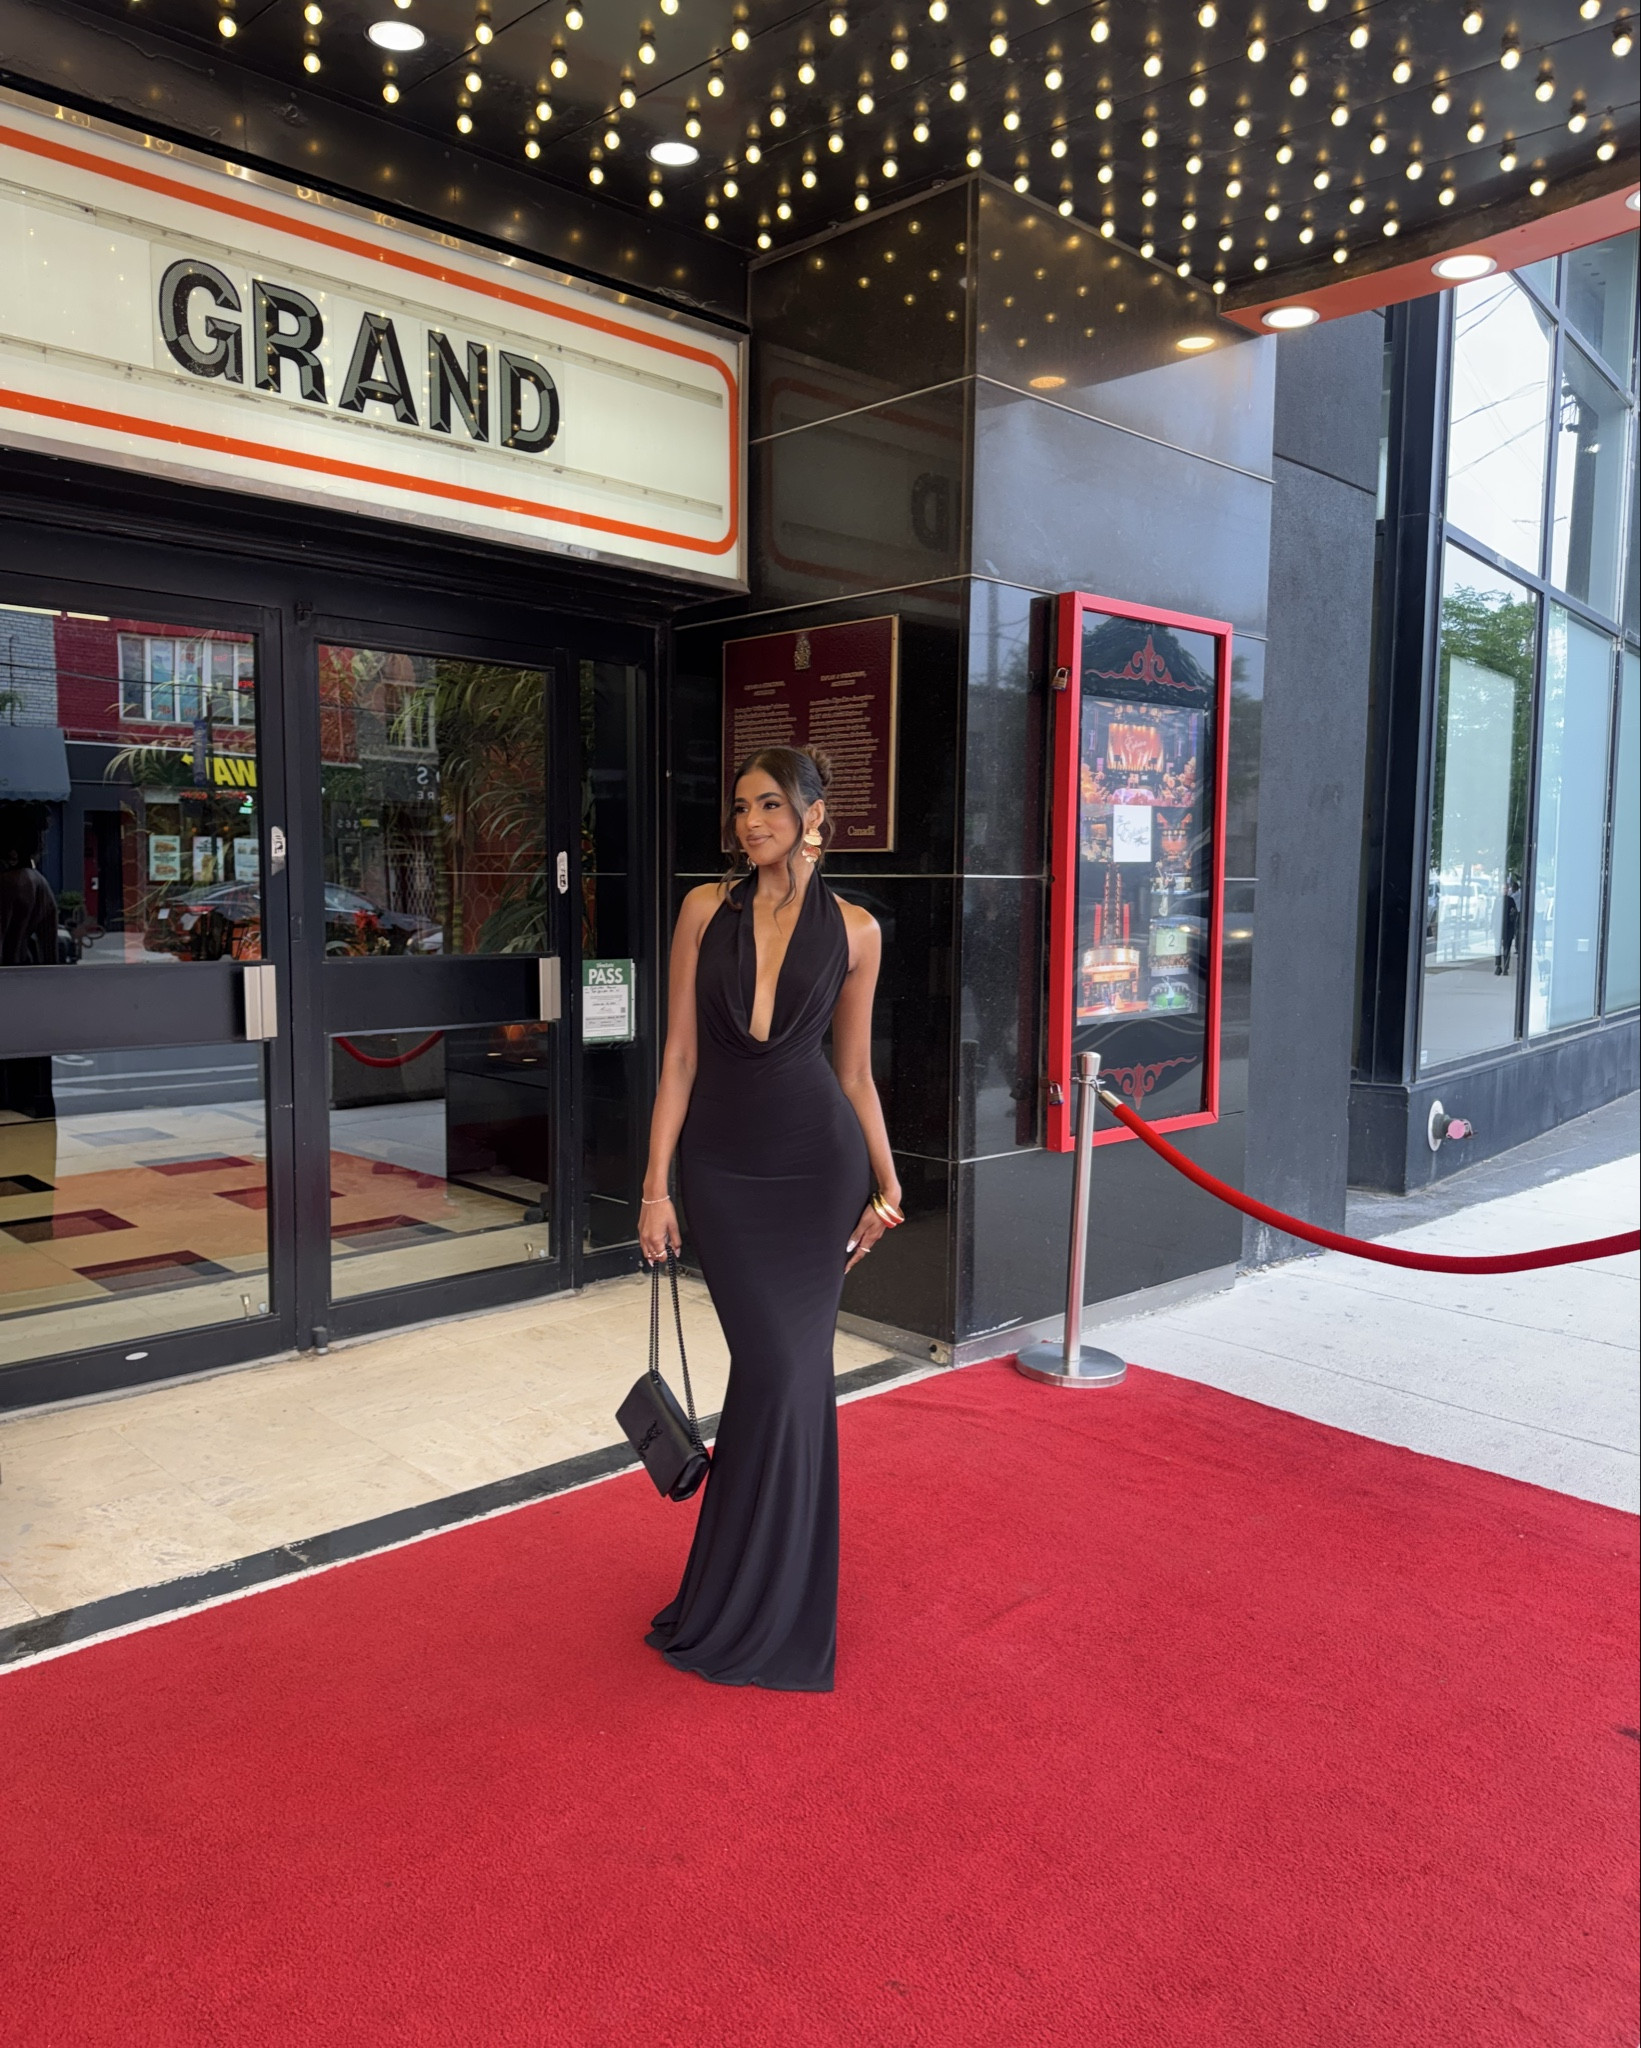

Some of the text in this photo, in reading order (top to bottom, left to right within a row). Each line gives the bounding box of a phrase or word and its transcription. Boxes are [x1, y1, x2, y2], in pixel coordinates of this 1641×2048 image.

[159, 259, 560, 453] GRAND
[1168, 934, 1175, 947] 2
[588, 968, 623, 985] PASS
